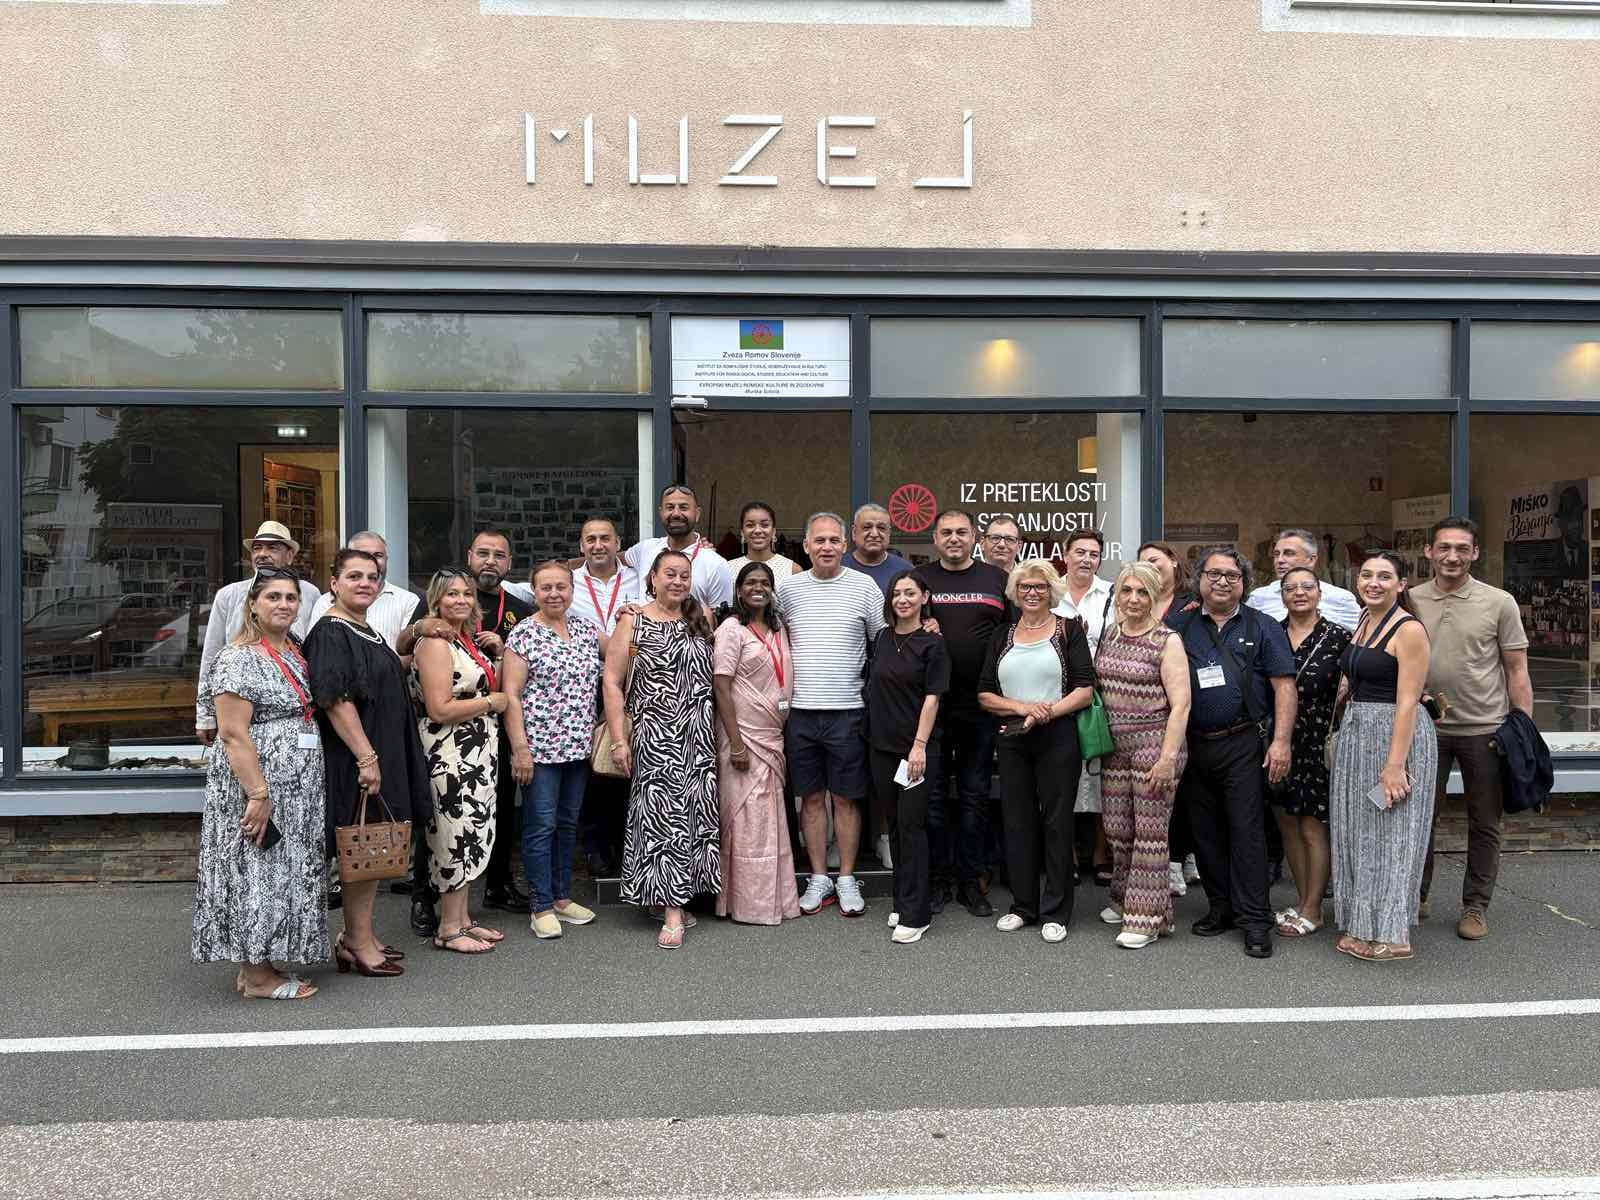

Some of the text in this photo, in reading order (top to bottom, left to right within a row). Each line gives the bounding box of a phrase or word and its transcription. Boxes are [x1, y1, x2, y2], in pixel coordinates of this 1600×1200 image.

[525, 109, 974, 188] MUZEJ
[722, 351, 801, 360] Zveza Romov Slovenije
[960, 482, 1107, 503] IZ PRETEKLOSTI
[977, 512, 1094, 533] SANJOSTI
[931, 592, 983, 602] MONCLER
